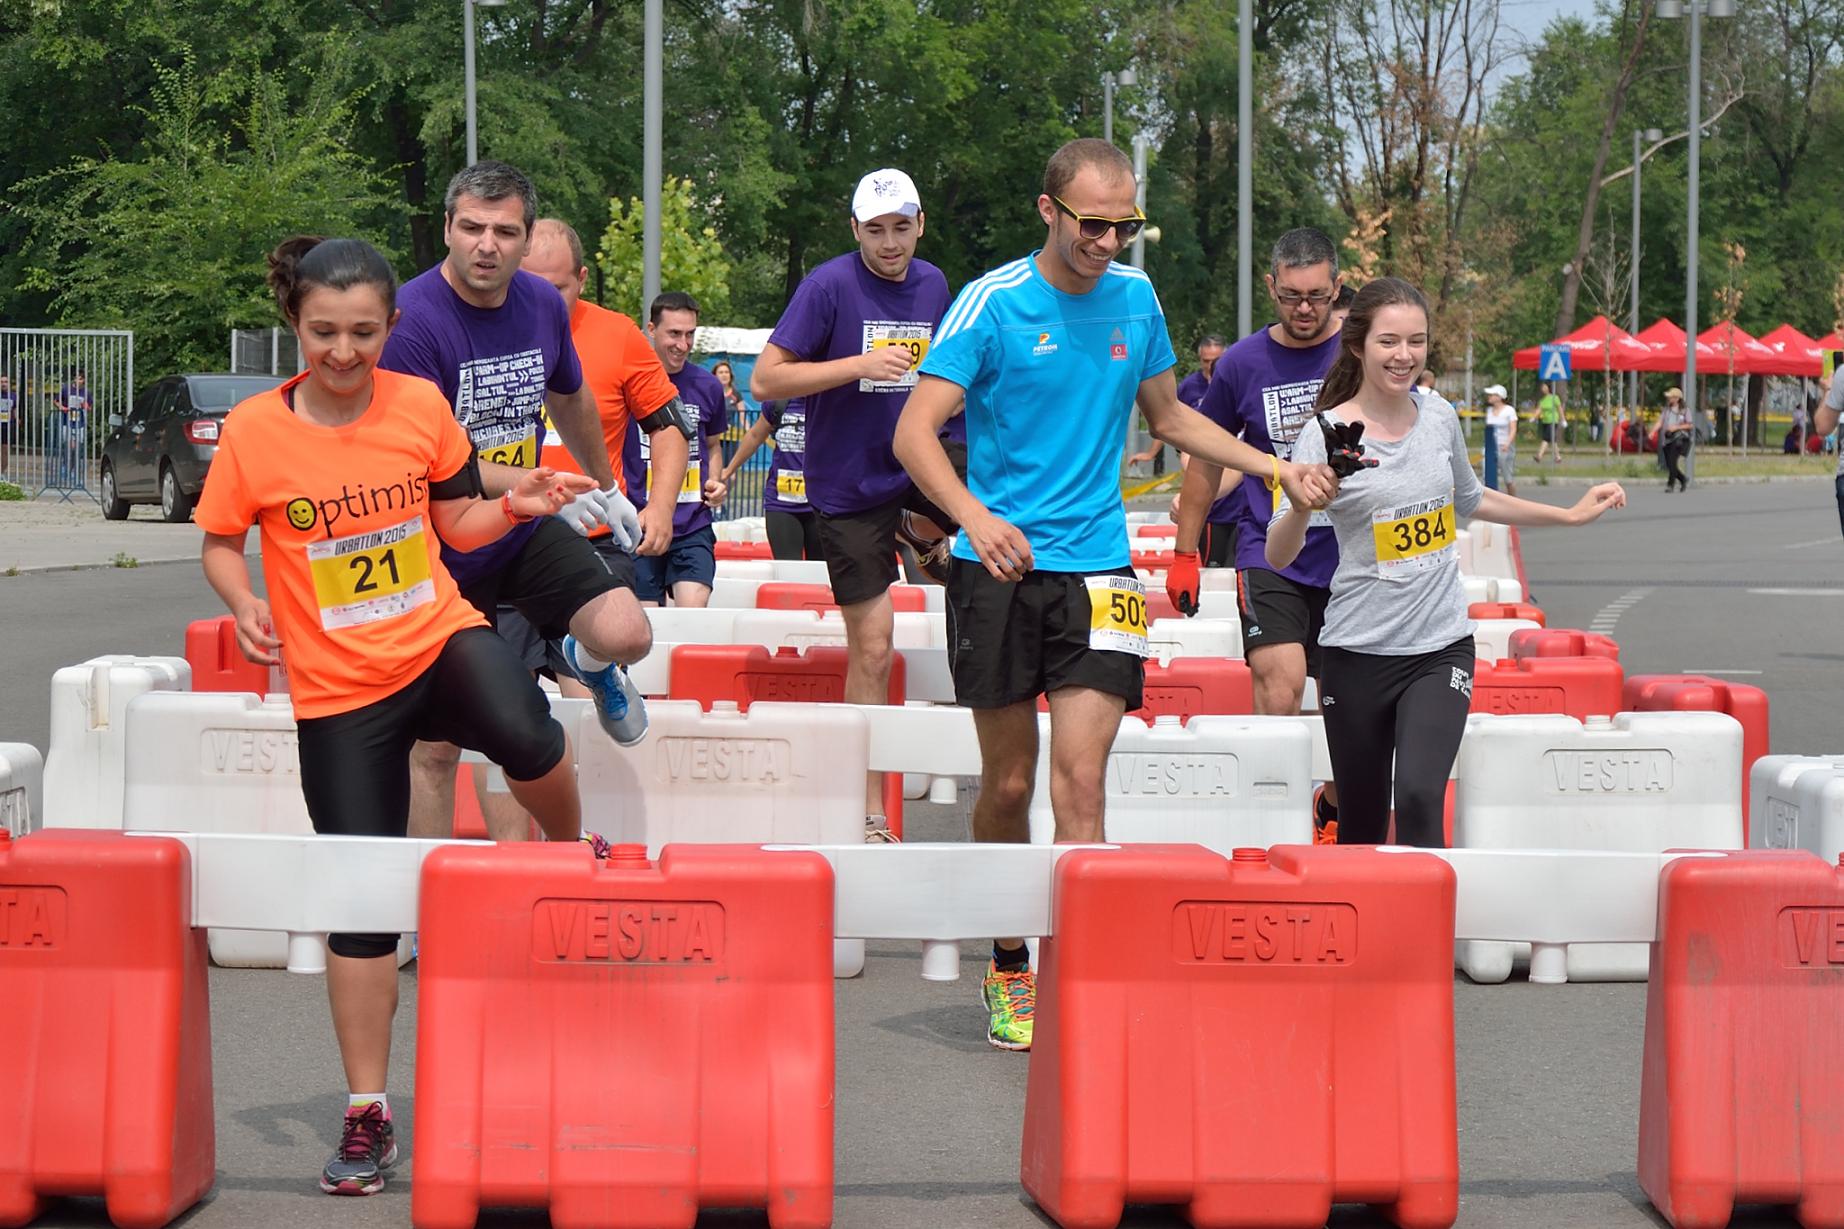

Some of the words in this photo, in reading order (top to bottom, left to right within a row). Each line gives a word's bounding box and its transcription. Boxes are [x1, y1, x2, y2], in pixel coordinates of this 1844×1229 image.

[1544, 352, 1567, 379] A
[335, 532, 383, 556] URBATLON
[384, 524, 407, 545] 2015
[1393, 511, 1446, 552] 384
[350, 549, 400, 594] 21
[665, 740, 781, 781] VESTA
[1115, 754, 1231, 795] VESTA
[1552, 751, 1665, 791] VESTA
[548, 903, 713, 961] VESTA
[1187, 905, 1345, 962] VESTA
